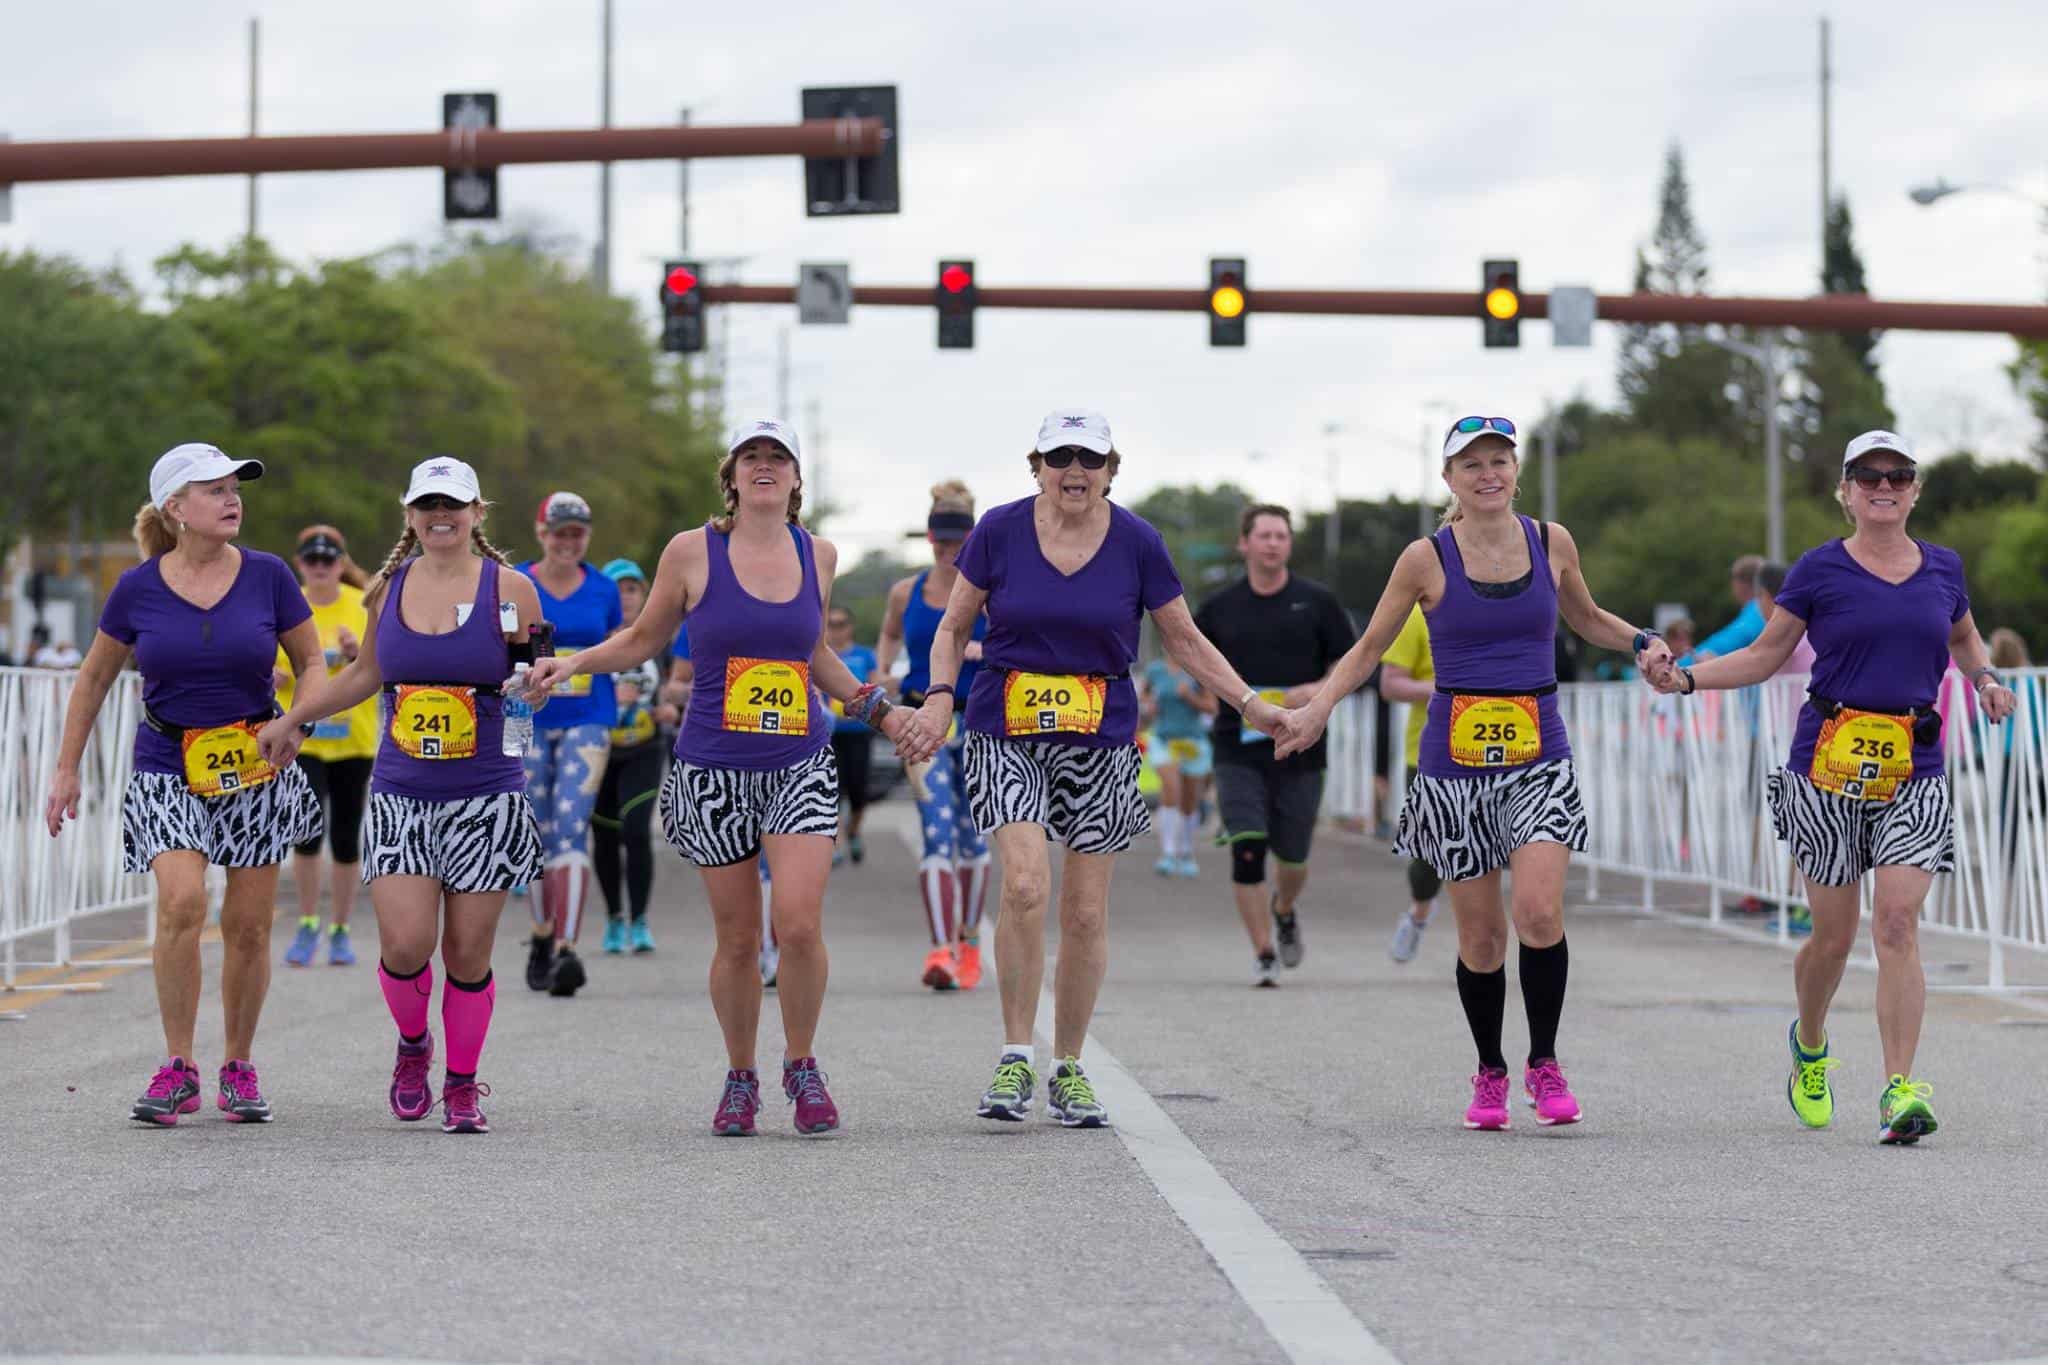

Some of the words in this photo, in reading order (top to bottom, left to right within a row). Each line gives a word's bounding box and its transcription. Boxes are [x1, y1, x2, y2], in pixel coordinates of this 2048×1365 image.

[748, 686, 794, 707] 240
[1025, 689, 1071, 707] 240
[413, 714, 450, 733] 241
[1473, 722, 1517, 741] 236
[1851, 738, 1894, 759] 236
[206, 749, 245, 770] 241
